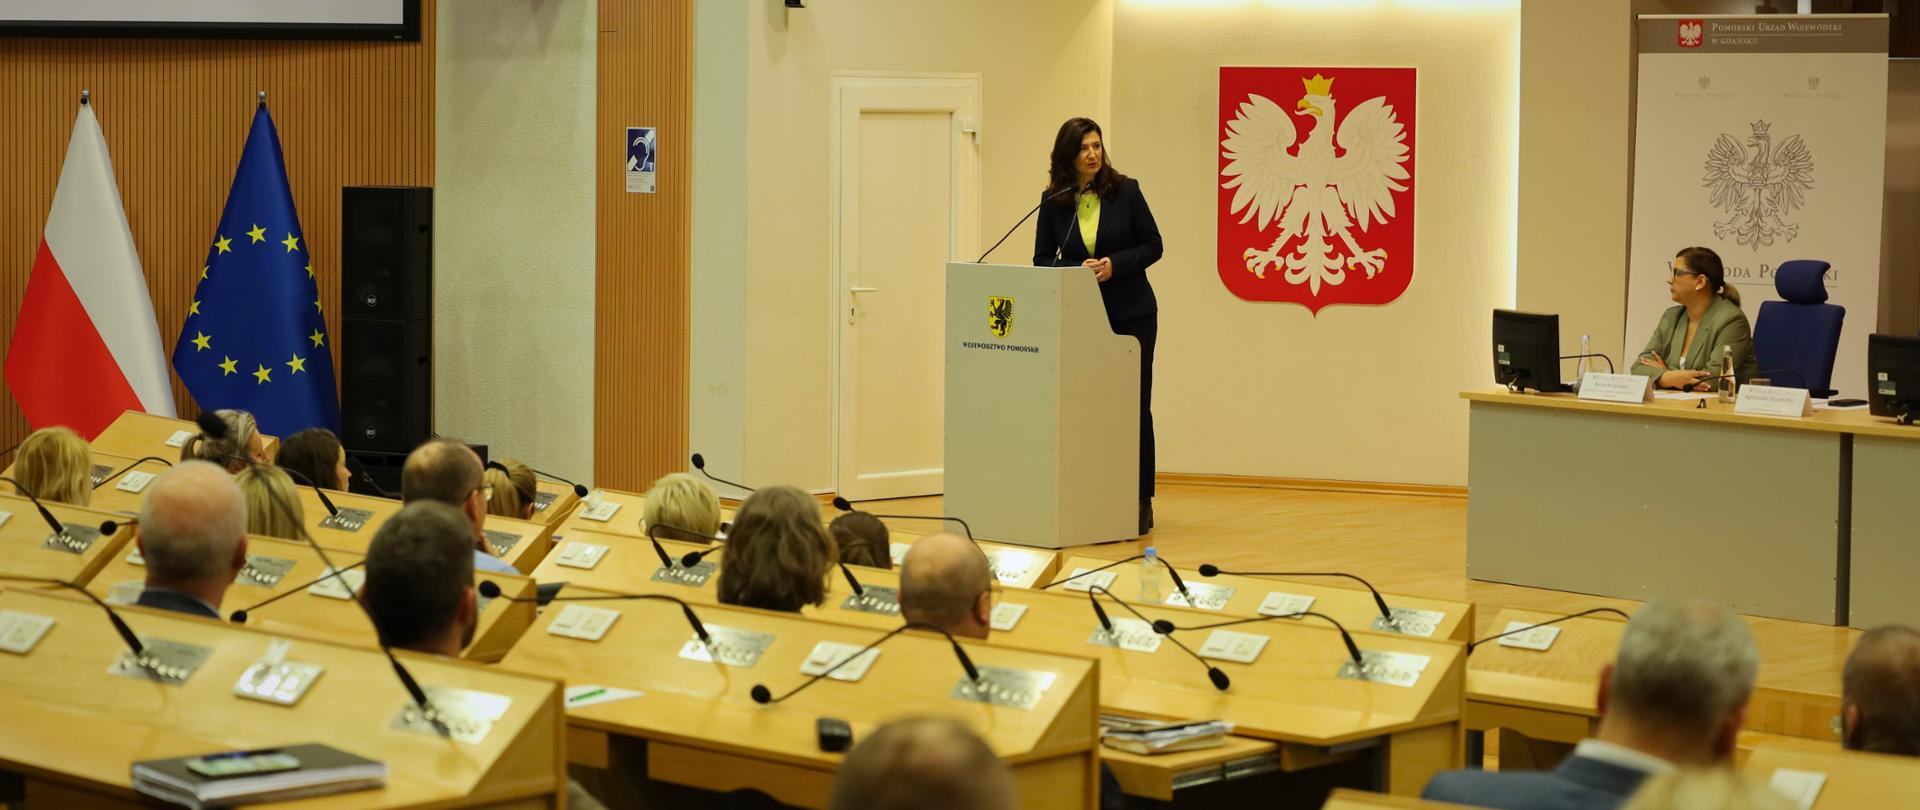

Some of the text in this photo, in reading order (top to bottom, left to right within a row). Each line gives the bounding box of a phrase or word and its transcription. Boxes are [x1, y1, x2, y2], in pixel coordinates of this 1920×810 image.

[1712, 22, 1842, 32] POMORSKI URZĄD WOJEWÓDZKI
[1007, 345, 1039, 353] POMORSKIE
